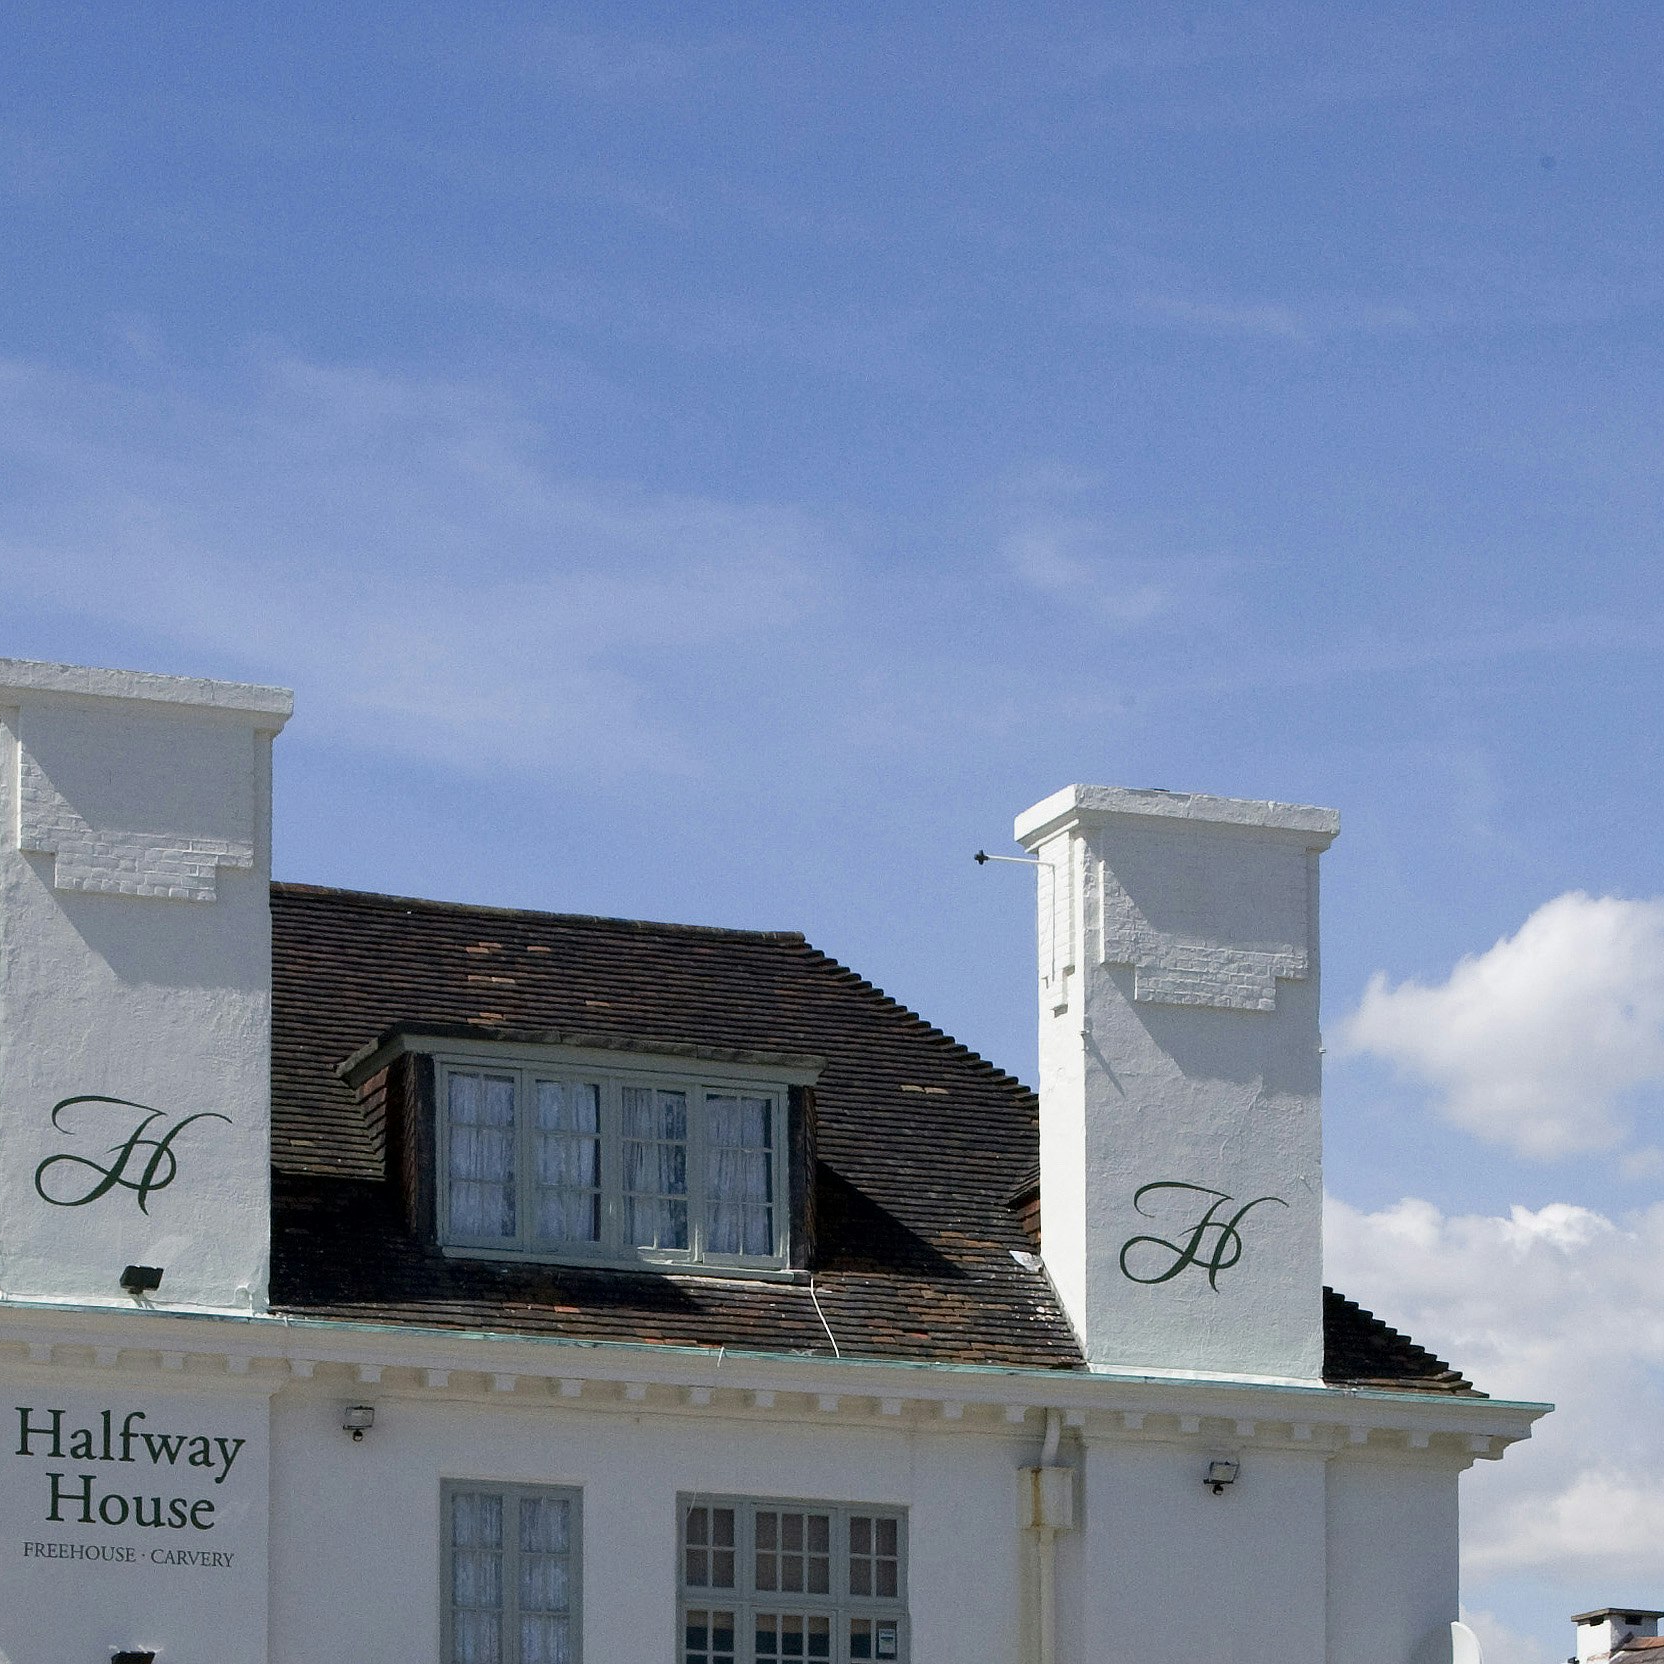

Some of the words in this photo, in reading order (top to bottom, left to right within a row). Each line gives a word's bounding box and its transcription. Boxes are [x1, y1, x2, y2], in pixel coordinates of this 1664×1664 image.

[14, 1407, 246, 1483] Halfway
[45, 1472, 215, 1530] House
[23, 1542, 136, 1563] FREEHOUSE
[150, 1549, 235, 1568] CARVERY
